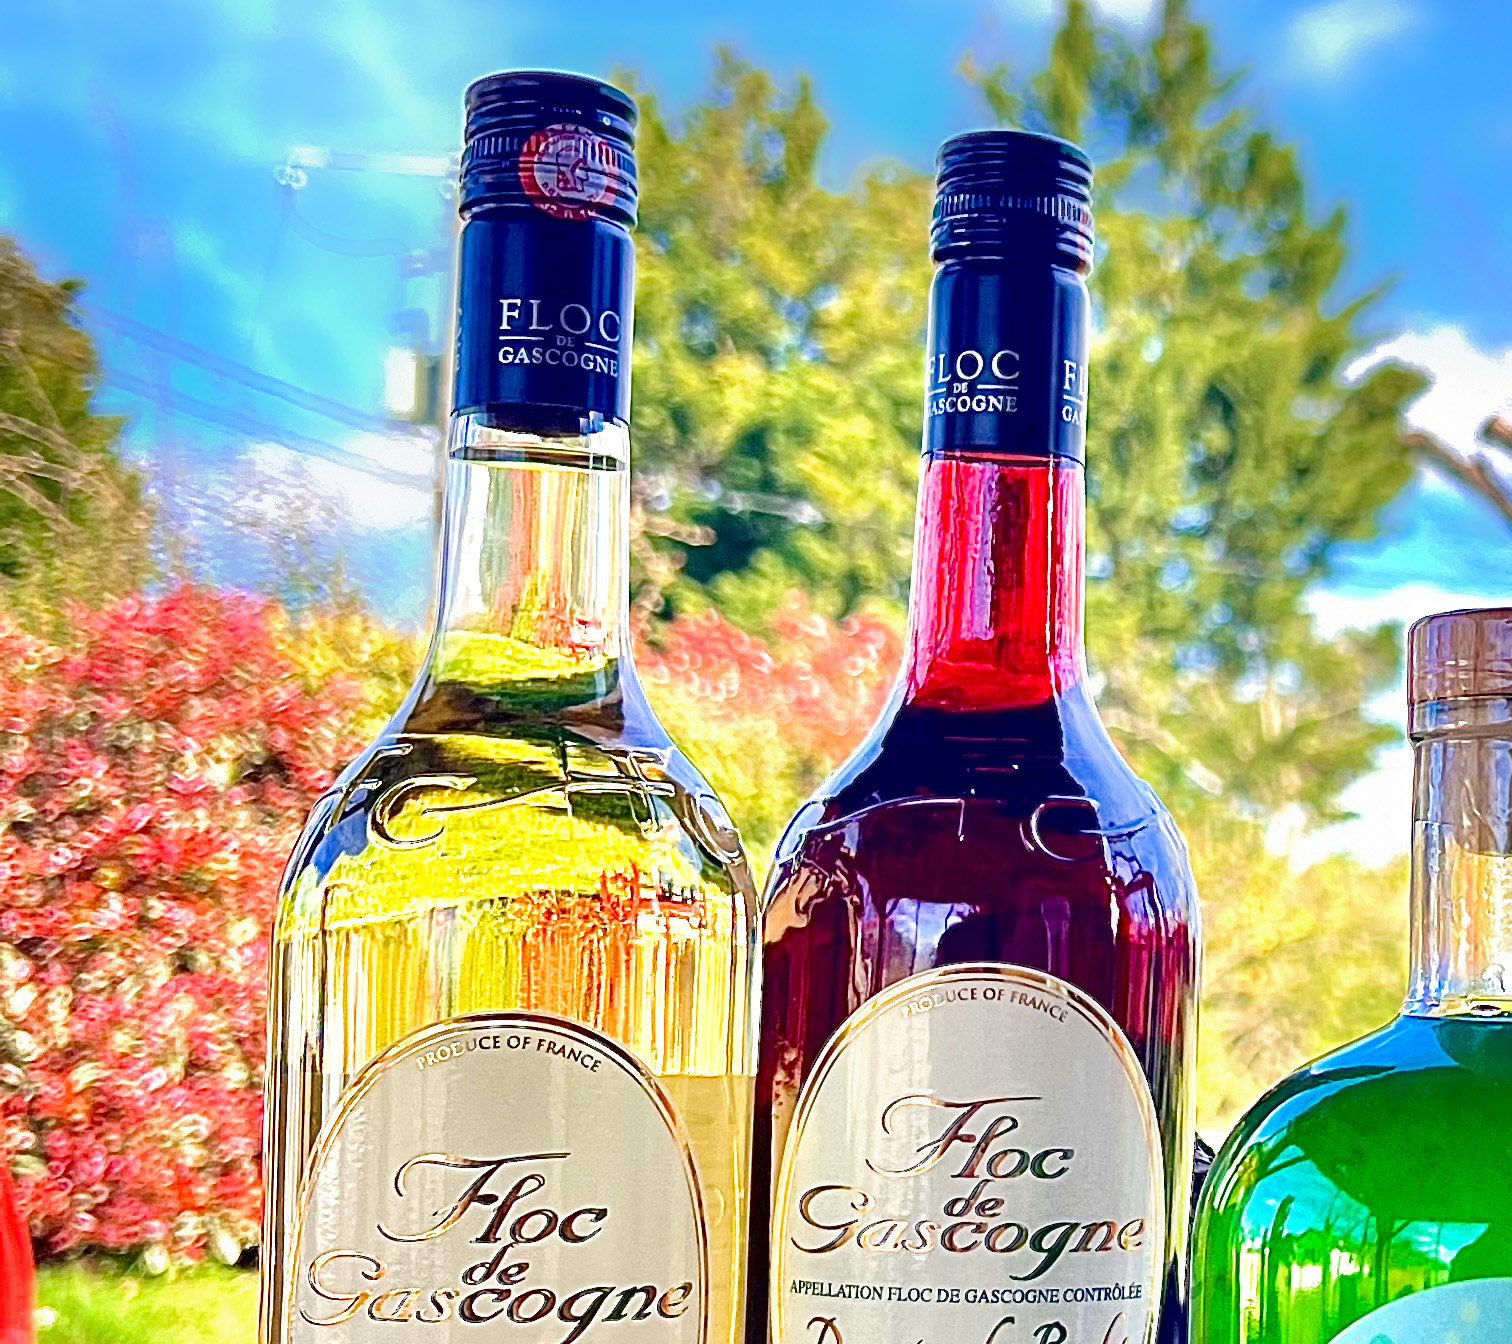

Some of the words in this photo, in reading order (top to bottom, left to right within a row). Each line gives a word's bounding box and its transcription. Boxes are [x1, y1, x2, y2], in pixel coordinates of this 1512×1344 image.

[499, 298, 621, 342] FLOC
[556, 334, 575, 348] DE
[498, 346, 618, 378] GASCOGNE
[929, 395, 1018, 417] ASCOGNE
[953, 381, 969, 394] DE
[901, 987, 978, 1020] PRODUCE
[983, 987, 1005, 1001] OF
[1010, 991, 1068, 1023] FRANCE
[415, 1035, 501, 1071] PRODUCE
[507, 1035, 532, 1050] OF
[536, 1038, 602, 1073] FRANCE
[866, 1094, 1075, 1179] Floc
[377, 1151, 608, 1244] Floc
[943, 1178, 1004, 1217] de
[790, 1184, 1144, 1282] Gascogne
[461, 1241, 529, 1287] de
[789, 1281, 883, 1301] APPELLATION
[887, 1286, 933, 1303] FLOC
[936, 1287, 960, 1303] DE
[964, 1287, 1059, 1304] GASCOGNE
[1063, 1281, 1142, 1302] CONTRÔLÉE
